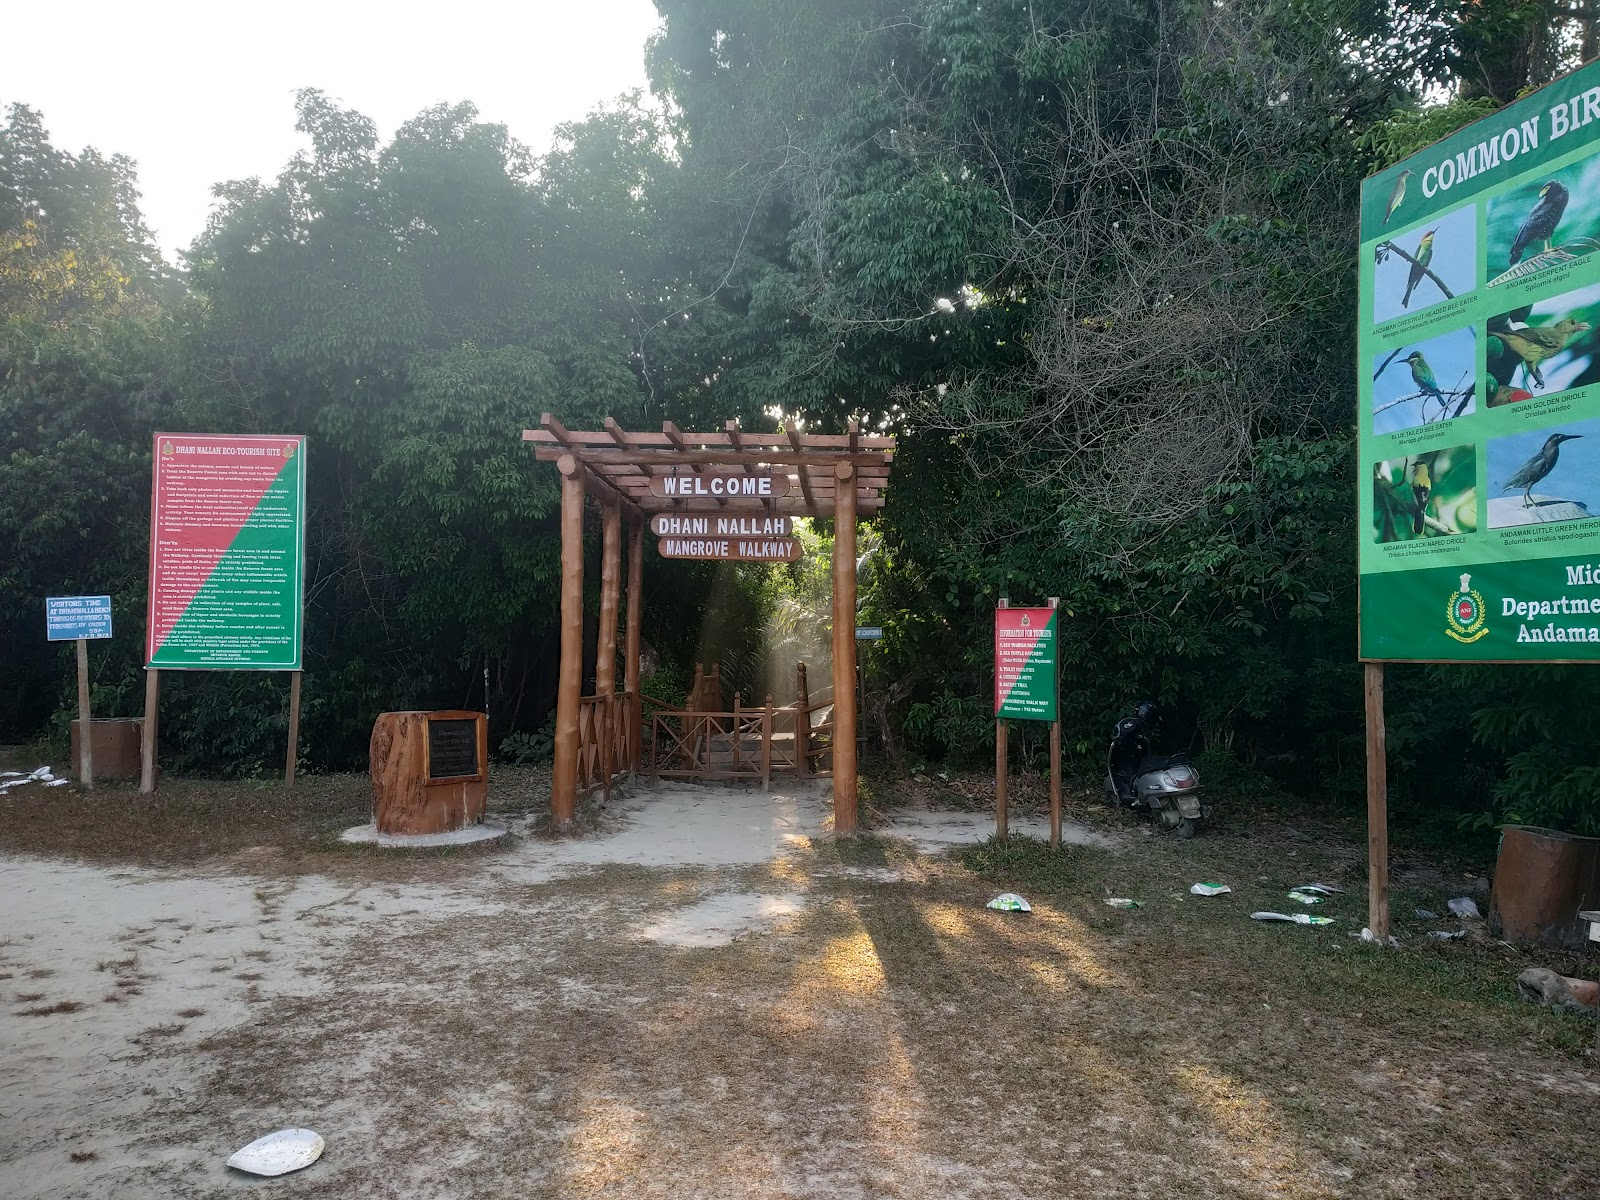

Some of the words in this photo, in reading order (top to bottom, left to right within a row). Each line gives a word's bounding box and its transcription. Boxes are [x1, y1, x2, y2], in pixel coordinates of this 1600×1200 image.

[1422, 115, 1540, 199] COMMON
[1506, 275, 1536, 290] ANDAMAN
[1538, 264, 1568, 280] SERPENT
[1569, 256, 1592, 268] EAGLE
[1553, 272, 1570, 282] elgini
[1372, 322, 1396, 336] ANDAMAN
[1398, 314, 1424, 326] CHESTNUT
[1426, 306, 1447, 317] HEADED
[1448, 302, 1458, 311] BEE
[1460, 296, 1478, 306] EATER
[1511, 404, 1532, 413] INDIAN
[1534, 398, 1560, 408] GOLDEN
[1562, 391, 1587, 402] ORIOLE
[1525, 409, 1547, 418] Oriolus
[1548, 404, 1571, 413] kundoo
[1406, 428, 1424, 436] TAILED
[1436, 421, 1452, 430] EATER
[176, 446, 196, 454] DHANI
[197, 446, 221, 454] NALLAH
[222, 447, 265, 455] ECO-TOURISM
[266, 448, 281, 456] SITE
[664, 477, 772, 495] WELCOME
[659, 518, 708, 534] DHANI
[718, 518, 785, 534] NALLAH
[1500, 529, 1531, 538] ANDAMAN
[1532, 526, 1553, 535] LITTLE
[1554, 524, 1578, 532] GREEN
[1446, 536, 1467, 544] ORIOLE
[1534, 535, 1556, 543] striatus
[666, 540, 729, 556] MANGROVE
[1516, 622, 1600, 642] Andama
